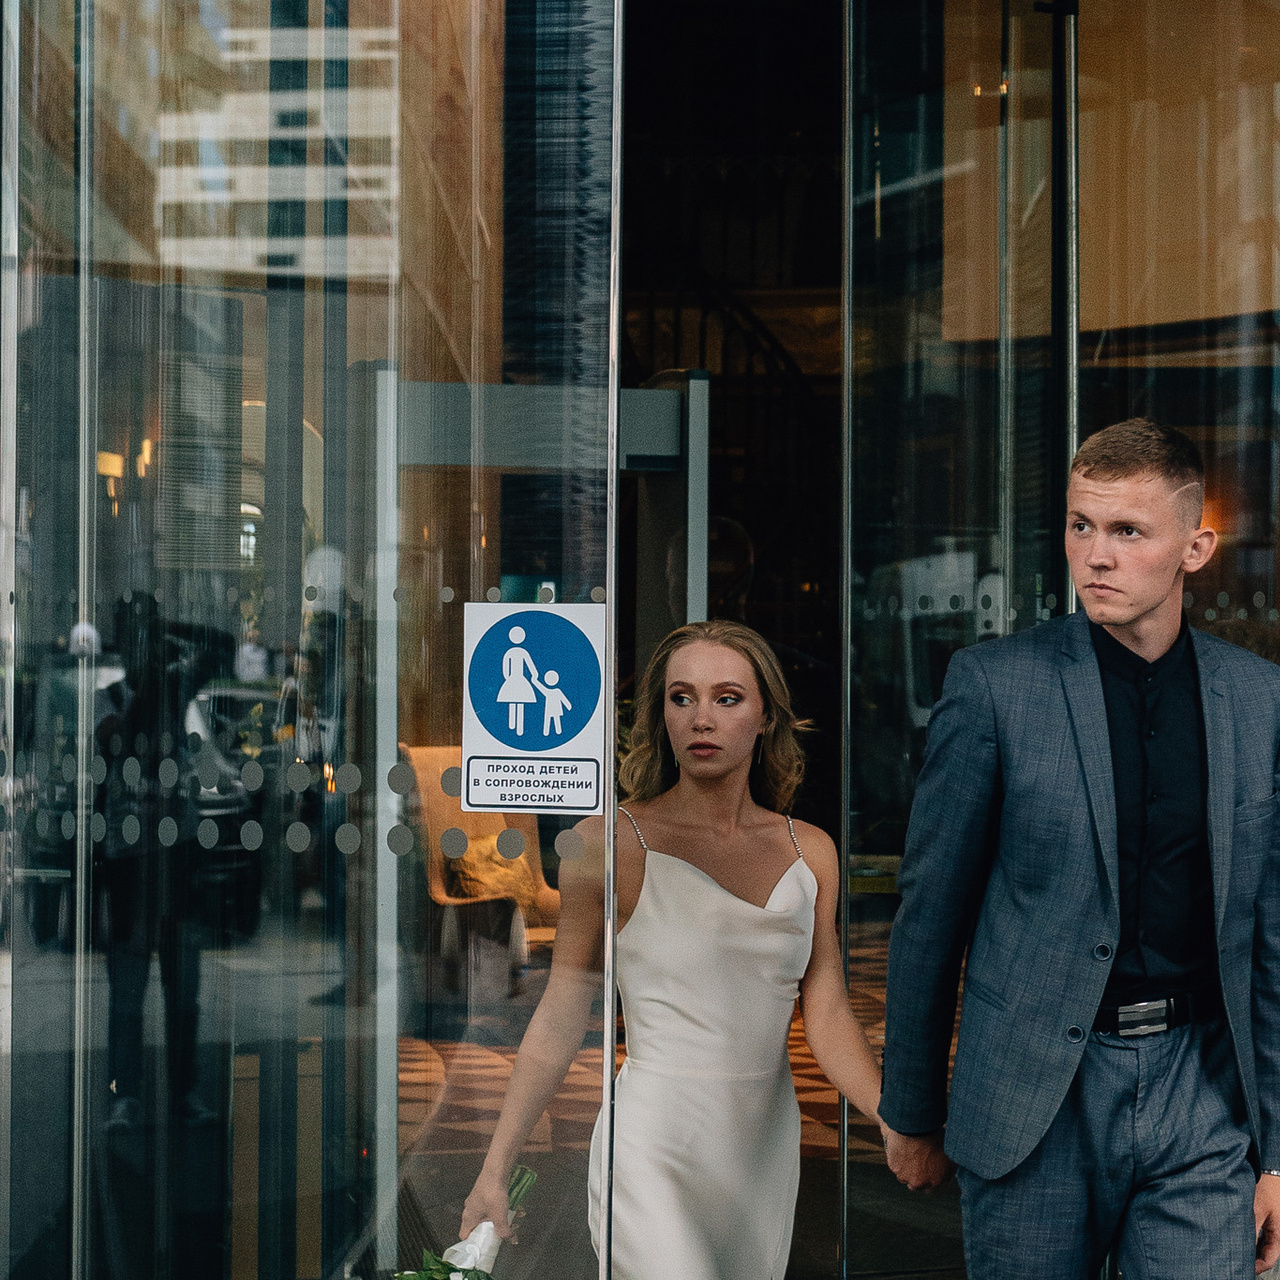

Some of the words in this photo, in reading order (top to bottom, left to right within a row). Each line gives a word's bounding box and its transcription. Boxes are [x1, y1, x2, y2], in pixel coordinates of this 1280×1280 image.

[487, 764, 535, 775] ПРОХОД
[540, 765, 578, 775] ДЕТЕЙ
[473, 778, 480, 787] В
[485, 778, 593, 790] СОПРОВОЖДЕНИИ
[500, 793, 565, 803] ВЗРОСЛЫХ
